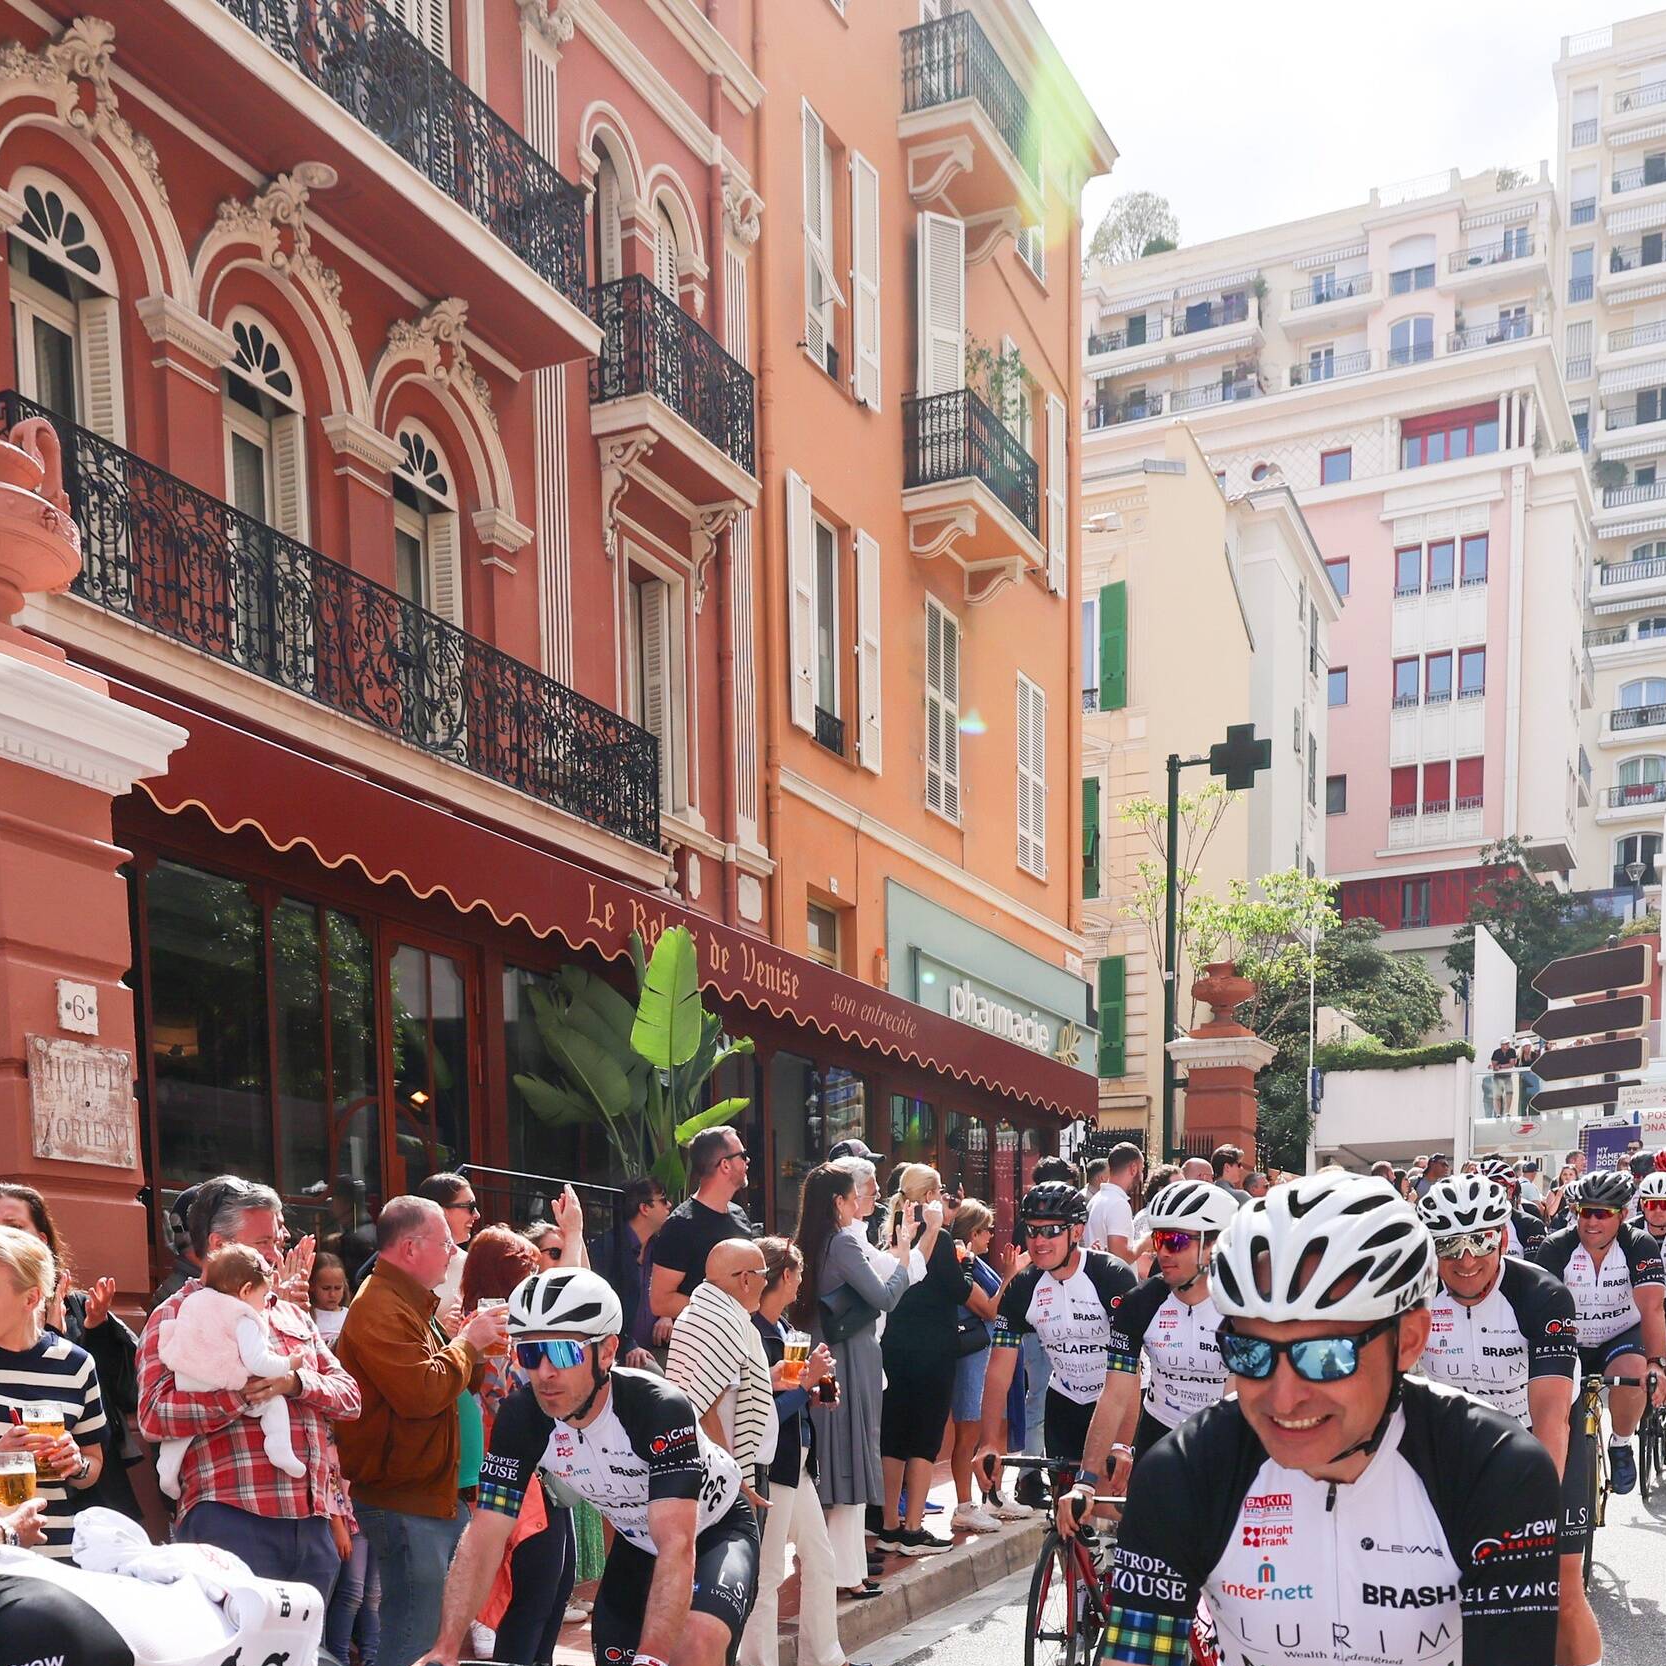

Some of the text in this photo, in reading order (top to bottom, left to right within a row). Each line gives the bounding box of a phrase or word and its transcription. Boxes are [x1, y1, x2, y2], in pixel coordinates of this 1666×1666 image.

[586, 883, 800, 1000] Le Rel de Venise
[72, 994, 85, 1021] 6
[831, 991, 918, 1039] son entrecôte
[949, 979, 1050, 1053] pharmacie
[1483, 1346, 1524, 1358] BRASH
[1565, 1506, 1588, 1526] LS
[1261, 1525, 1293, 1537] Knight
[1503, 1518, 1557, 1540] rew
[1261, 1537, 1289, 1547] Frank
[1221, 1580, 1314, 1601] inter-nett
[1363, 1582, 1457, 1610] BRASH
[1461, 1580, 1561, 1603] ELEVANC
[1240, 1616, 1451, 1654] LURIM
[1284, 1650, 1328, 1659] Wealth
